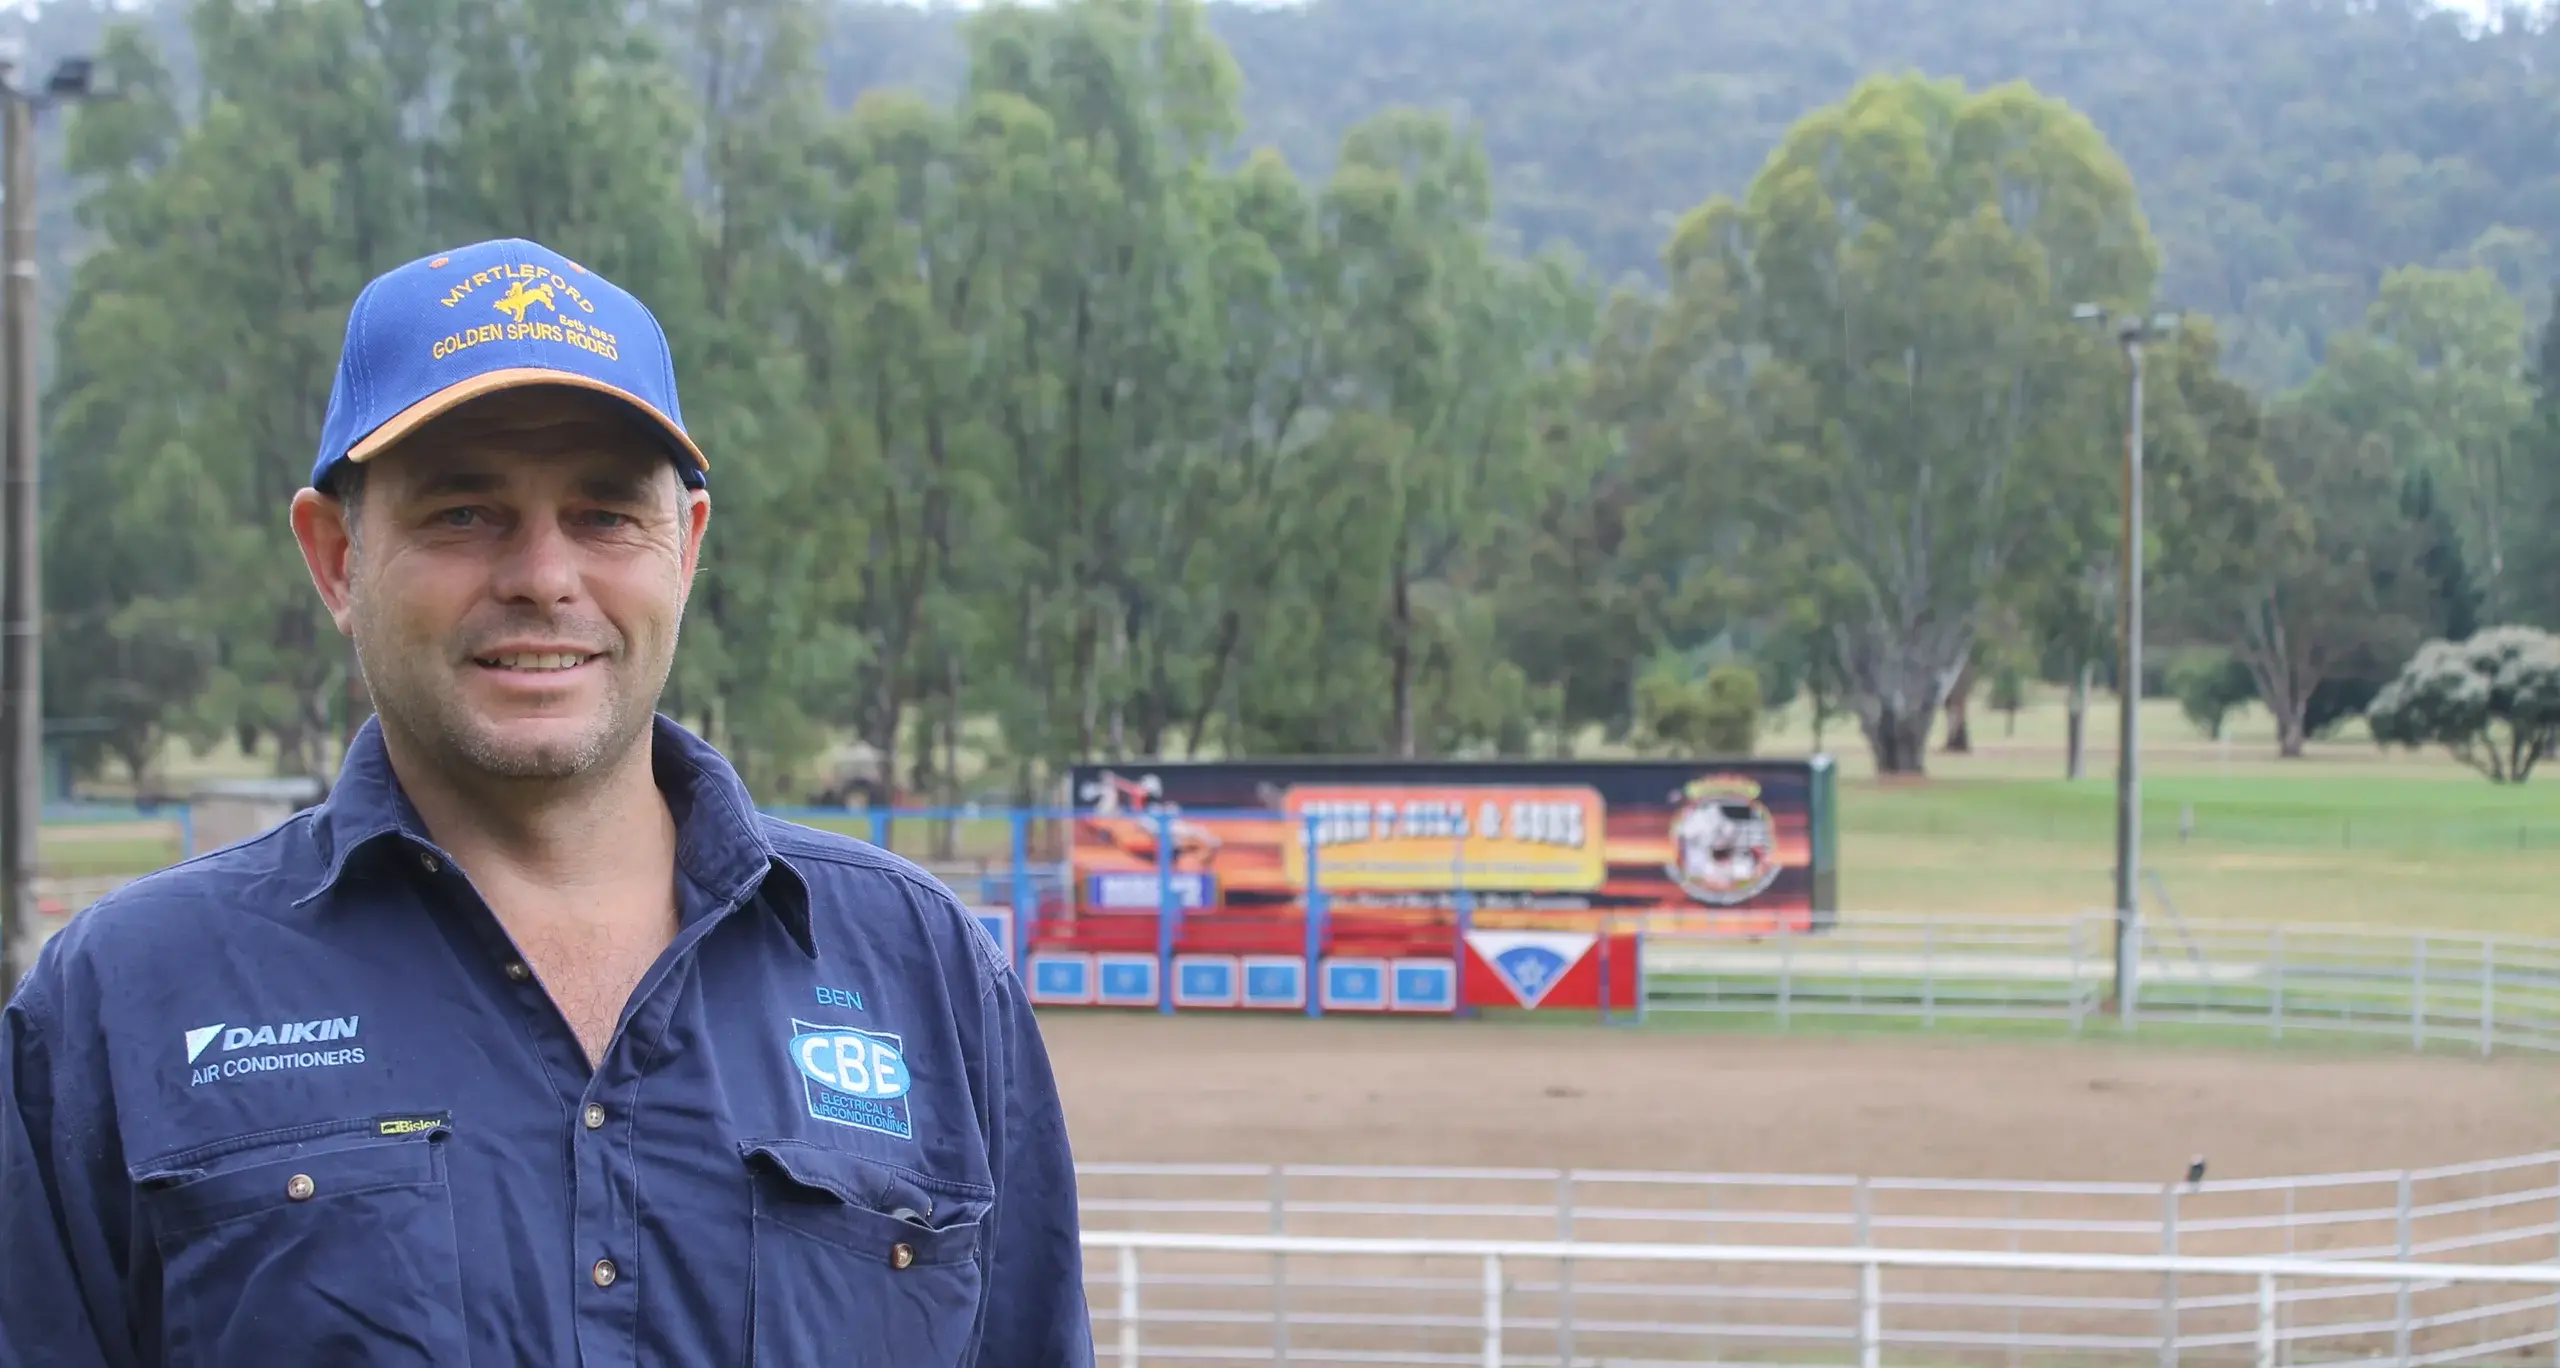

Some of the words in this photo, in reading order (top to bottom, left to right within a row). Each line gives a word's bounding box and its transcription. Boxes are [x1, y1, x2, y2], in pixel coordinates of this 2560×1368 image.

[441, 263, 595, 313] MYRTLEFORD
[432, 323, 502, 360] GOLDEN
[507, 322, 562, 342] SPURS
[566, 329, 618, 361] RODEO
[815, 986, 864, 1011] BEN
[222, 1015, 359, 1051] DAIKIN
[191, 1064, 220, 1087] AIR
[223, 1047, 366, 1077] CONDITIONERS
[802, 1036, 901, 1094] CBE
[812, 1103, 908, 1133] AIRCONDITIONING
[821, 1092, 886, 1116] ELECTRICAL
[887, 1106, 896, 1119] &
